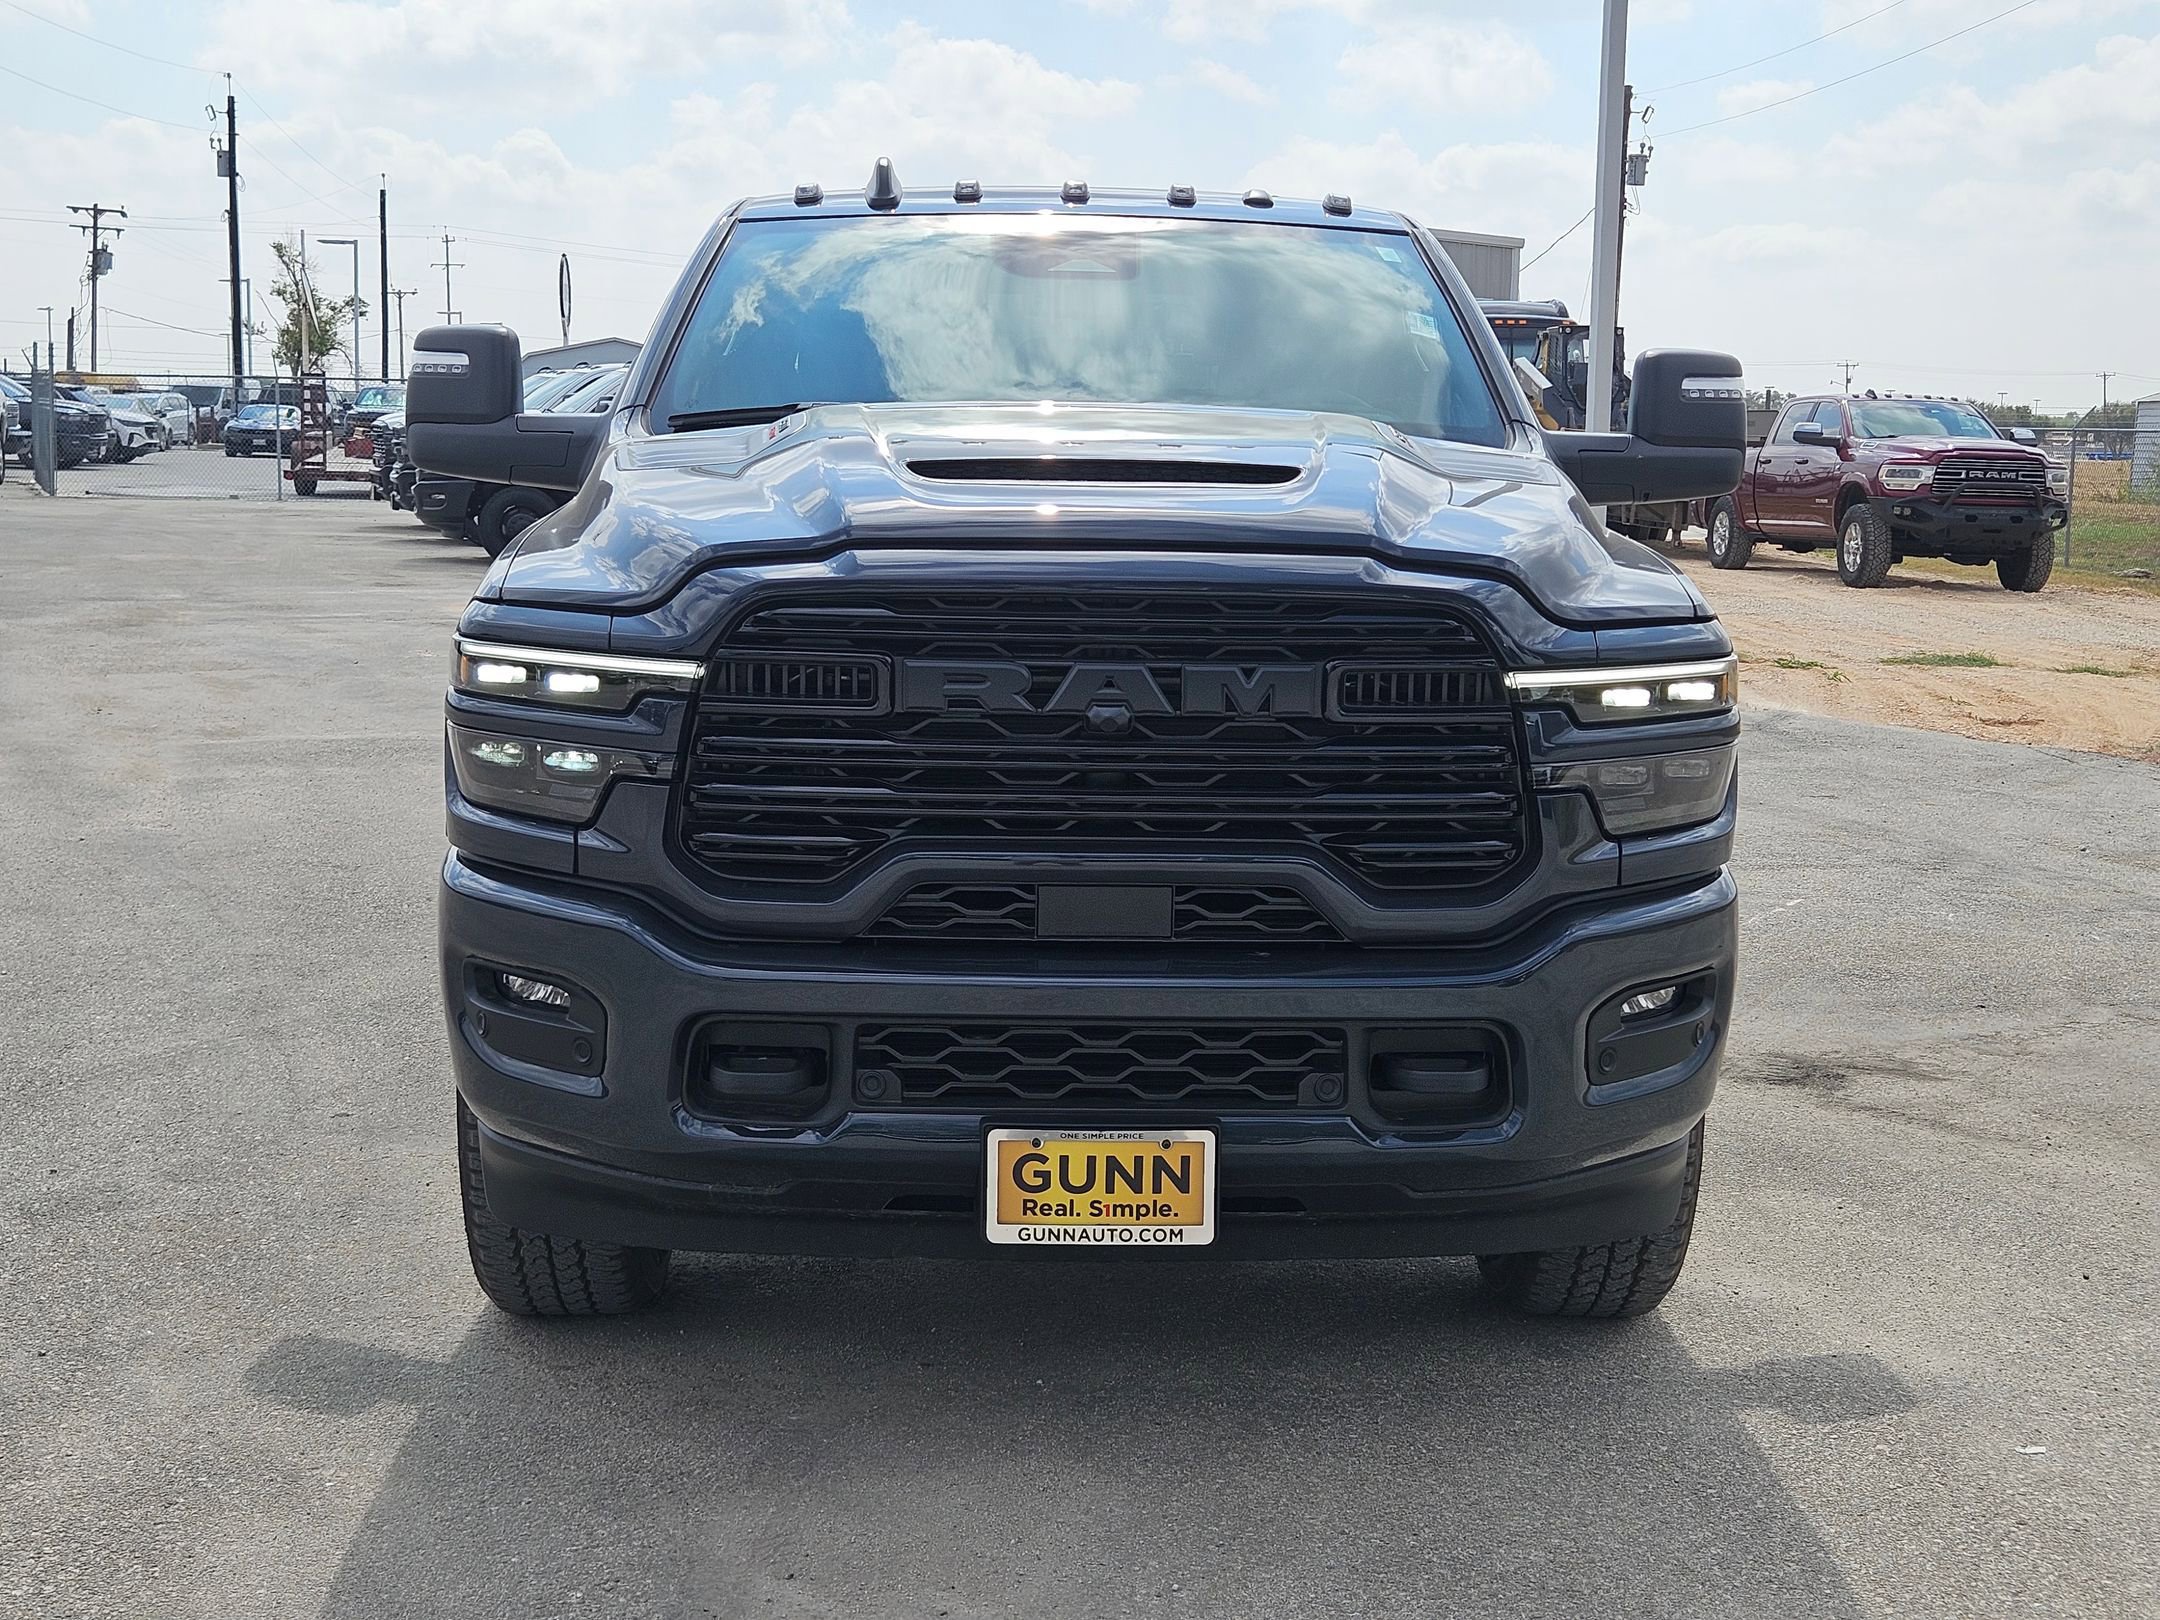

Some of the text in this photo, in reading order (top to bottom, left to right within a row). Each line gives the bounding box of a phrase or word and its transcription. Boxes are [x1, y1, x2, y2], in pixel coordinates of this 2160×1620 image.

[1968, 470, 2017, 479] RAM
[903, 658, 1317, 716] RAM
[1060, 1132, 1080, 1140] ONE
[1012, 1152, 1191, 1195] GUNN
[1022, 1198, 1081, 1217] Real.
[1017, 1227, 1184, 1243] GUNNAUTO.COM
